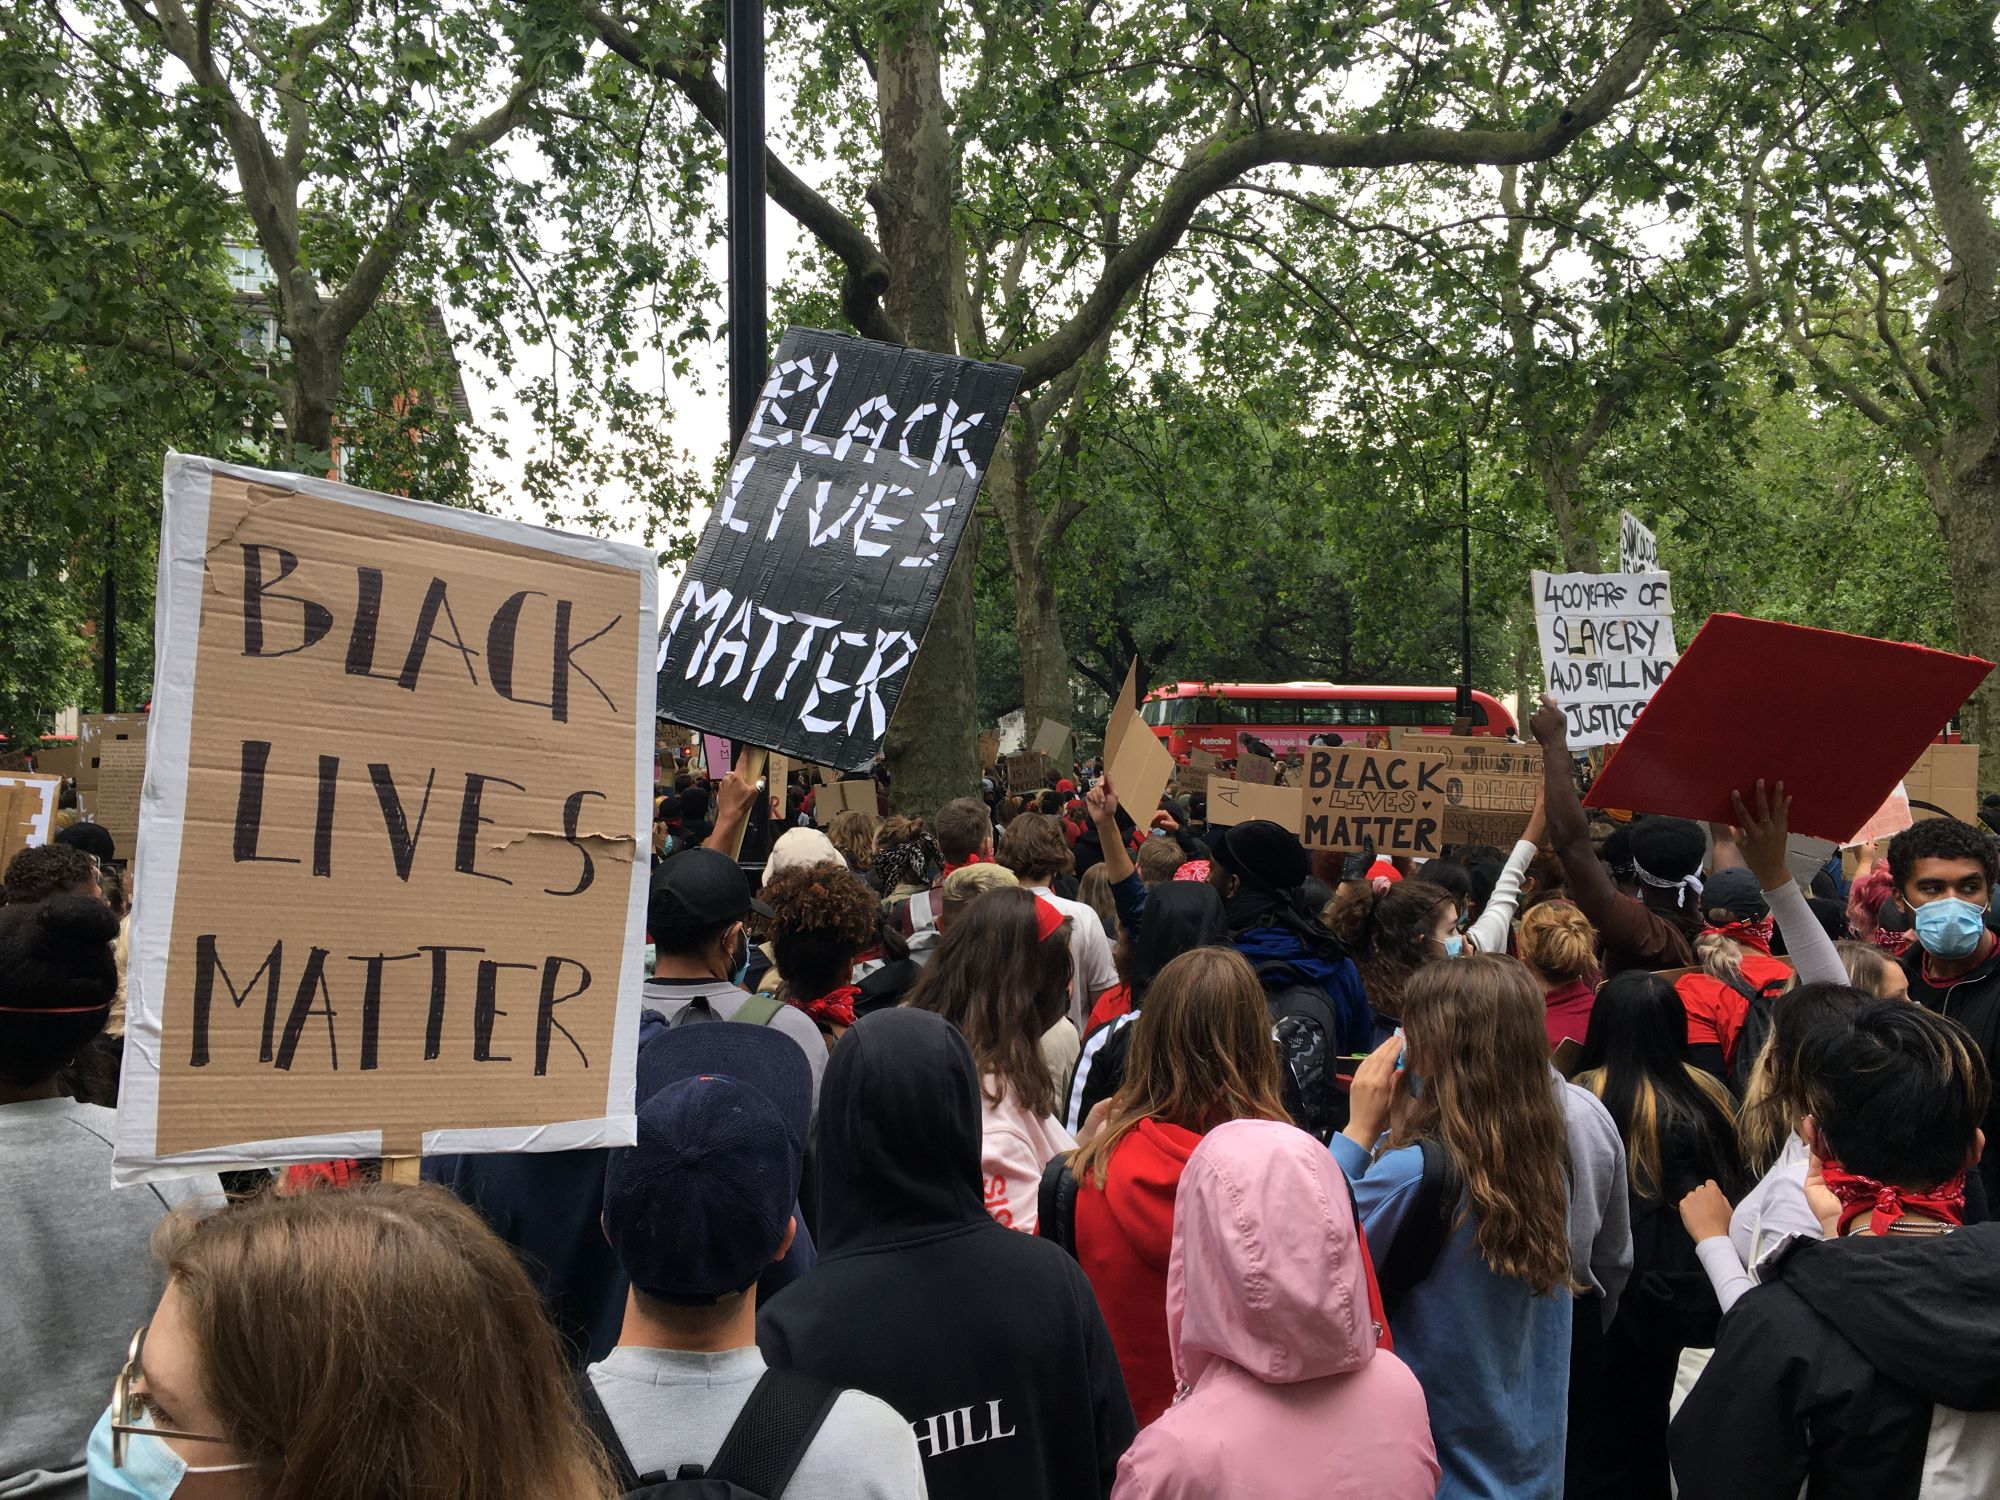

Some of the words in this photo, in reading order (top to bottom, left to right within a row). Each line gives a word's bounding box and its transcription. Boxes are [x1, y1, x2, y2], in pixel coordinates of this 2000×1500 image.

[748, 352, 985, 480] BLACK
[720, 456, 957, 568] LIVES
[1639, 582, 1667, 609] OF
[240, 543, 622, 724] BLACK
[1553, 616, 1659, 657] SLAVERY
[657, 580, 918, 741] MATTER
[1551, 661, 1582, 695] AND
[1586, 660, 1640, 693] STILL
[1200, 737, 1232, 746] Metroline
[1265, 739, 1279, 747] this
[1280, 739, 1295, 747] look
[1309, 752, 1445, 794] BLACK
[1462, 746, 1543, 778] JUSTIC
[1329, 789, 1417, 813] LIVES
[1473, 779, 1537, 814] PEAC
[233, 740, 607, 896] LIVES
[1304, 815, 1437, 852] MATTER
[189, 934, 592, 1077] MATTER
